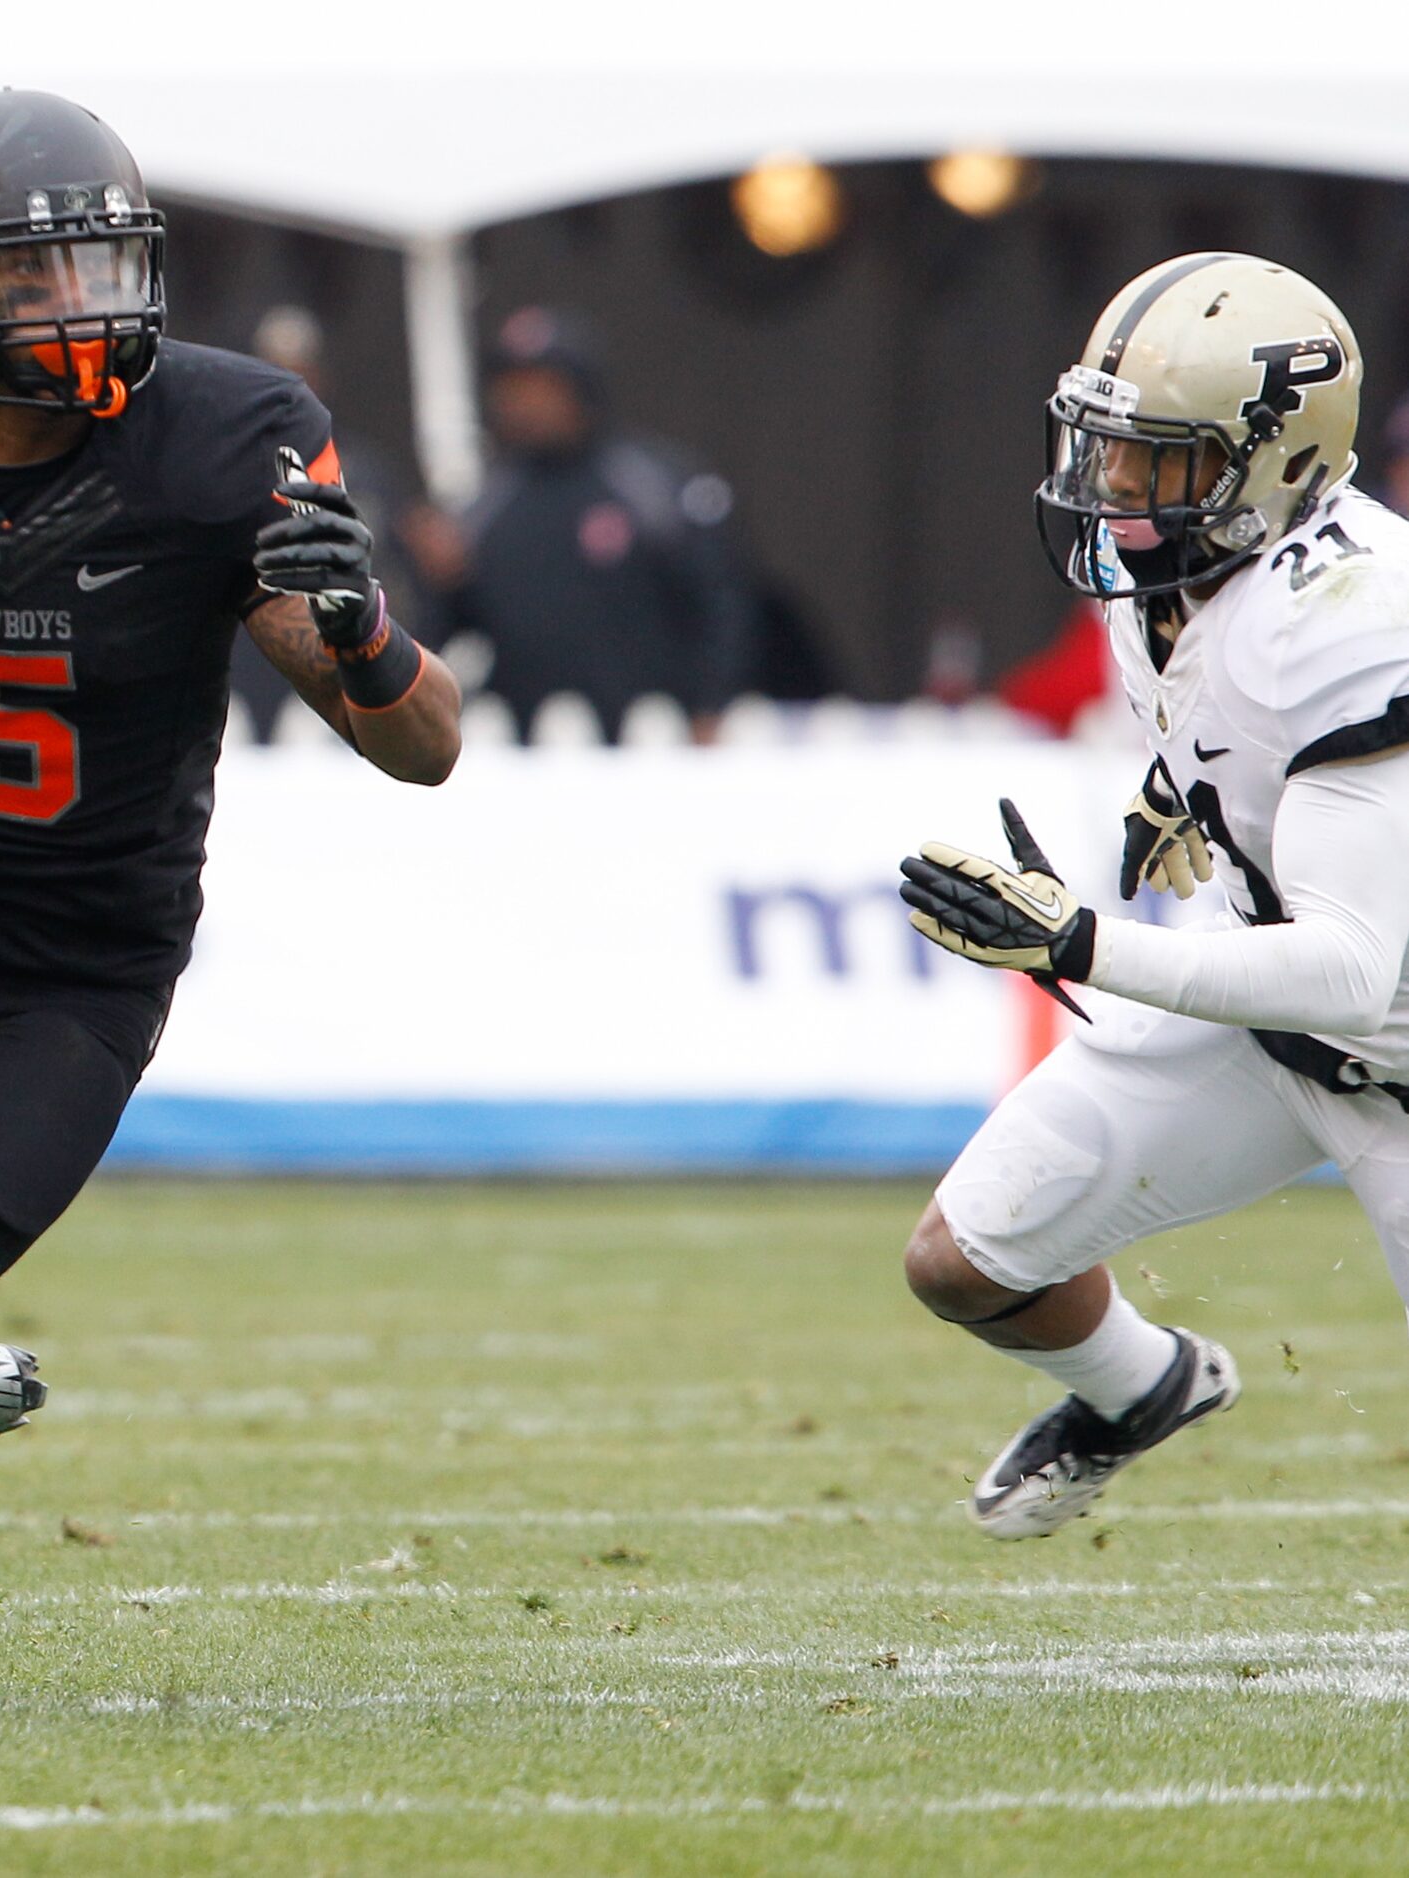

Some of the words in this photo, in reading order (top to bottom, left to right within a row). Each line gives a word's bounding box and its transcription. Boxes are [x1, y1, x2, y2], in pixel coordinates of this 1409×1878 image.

[1237, 335, 1345, 422] P
[1199, 465, 1240, 509] Riddell
[1270, 521, 1374, 592] 21
